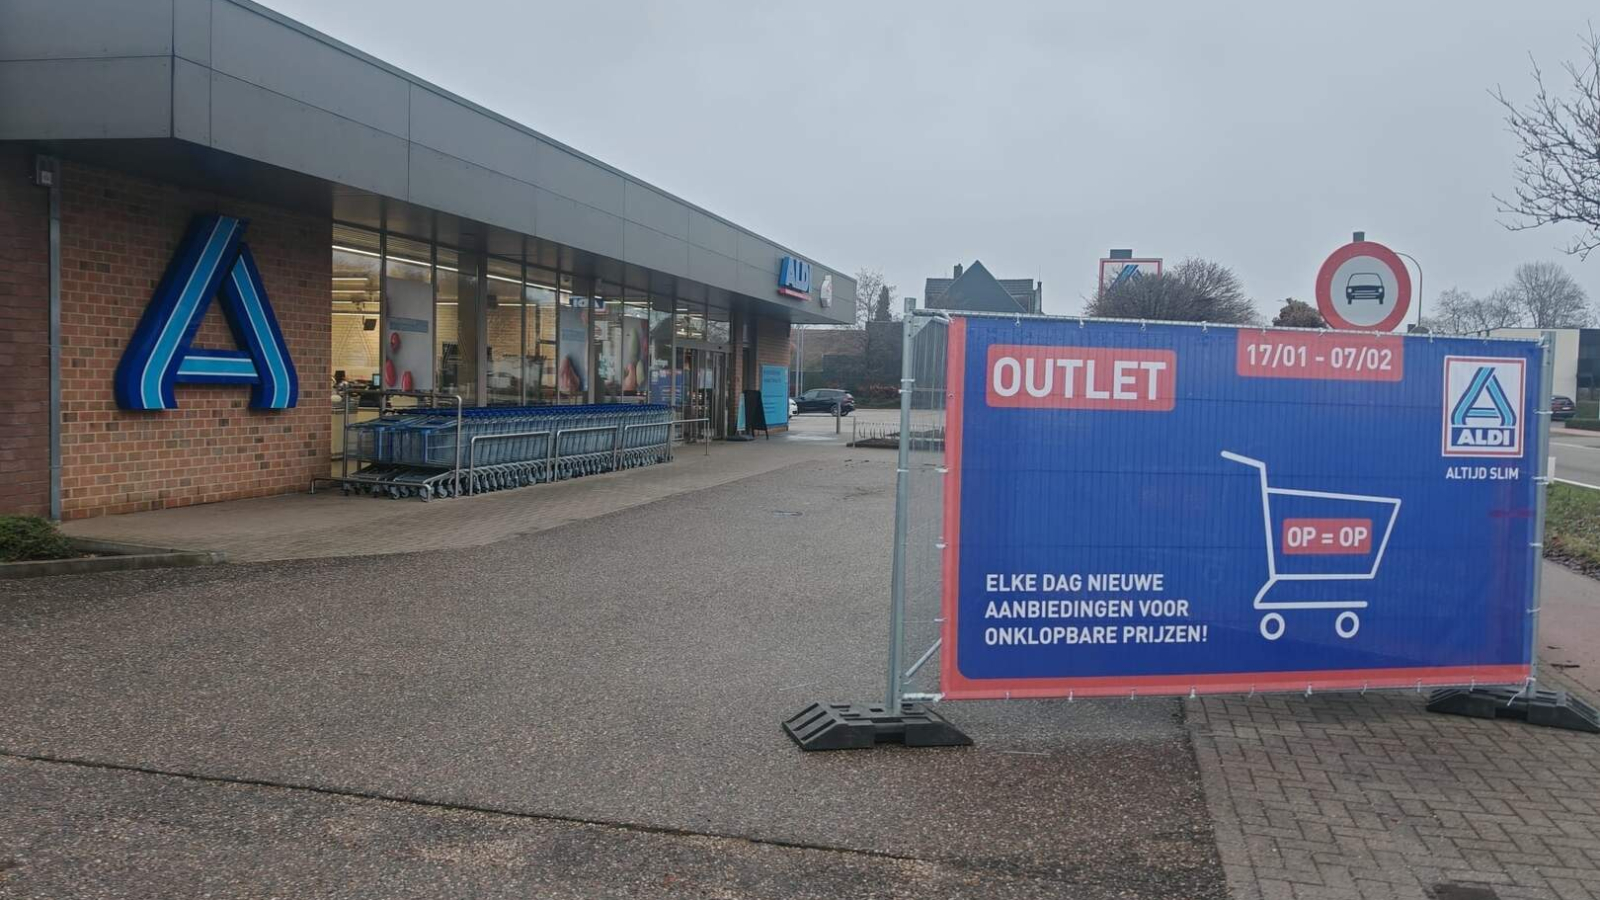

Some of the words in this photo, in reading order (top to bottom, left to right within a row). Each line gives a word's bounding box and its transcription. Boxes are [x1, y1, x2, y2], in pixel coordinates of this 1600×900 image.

[784, 256, 813, 293] ALDI
[1247, 343, 1307, 368] 17/01
[1331, 346, 1392, 371] 07/02
[993, 356, 1167, 400] OUTLET
[1457, 428, 1511, 446] ALDI
[1446, 466, 1487, 479] ALTIJD
[1489, 467, 1519, 480] SLIM
[1287, 526, 1317, 547] OP
[1339, 526, 1368, 547] OP
[986, 573, 1038, 592] ELKE
[1042, 573, 1082, 591] DAG
[1087, 573, 1164, 591] NIEUWE
[984, 600, 1134, 618] AANBIEDINGEN
[1138, 599, 1189, 617] VOOR
[984, 626, 1117, 645] ONKLOPBARE
[1122, 624, 1208, 643] PRIJZEN!
